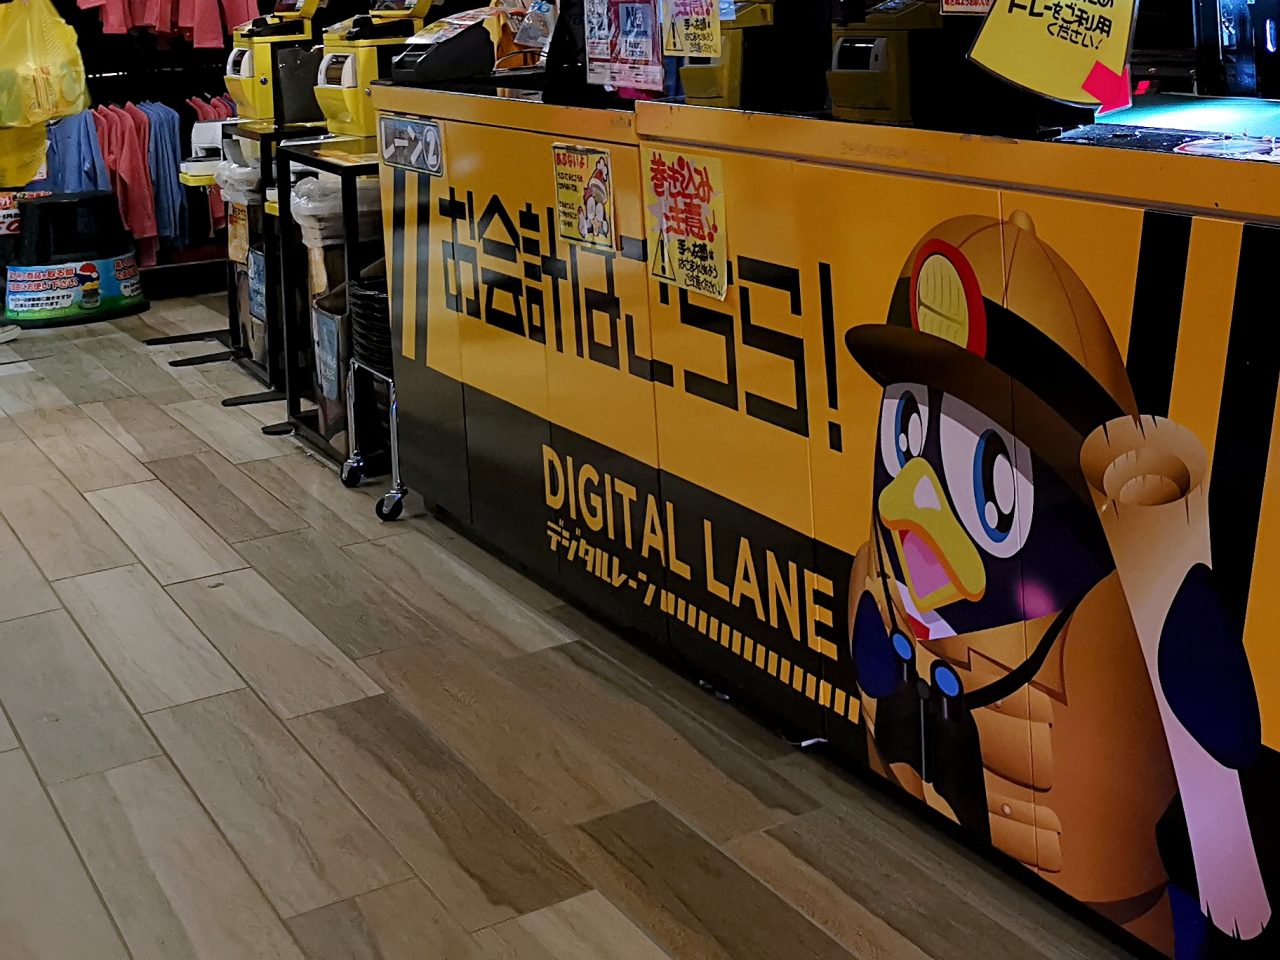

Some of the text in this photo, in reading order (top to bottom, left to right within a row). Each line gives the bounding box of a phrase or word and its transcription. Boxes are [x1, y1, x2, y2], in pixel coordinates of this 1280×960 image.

[1046, 23, 1104, 51] ください！
[541, 443, 839, 662] DIGITAL LANE
